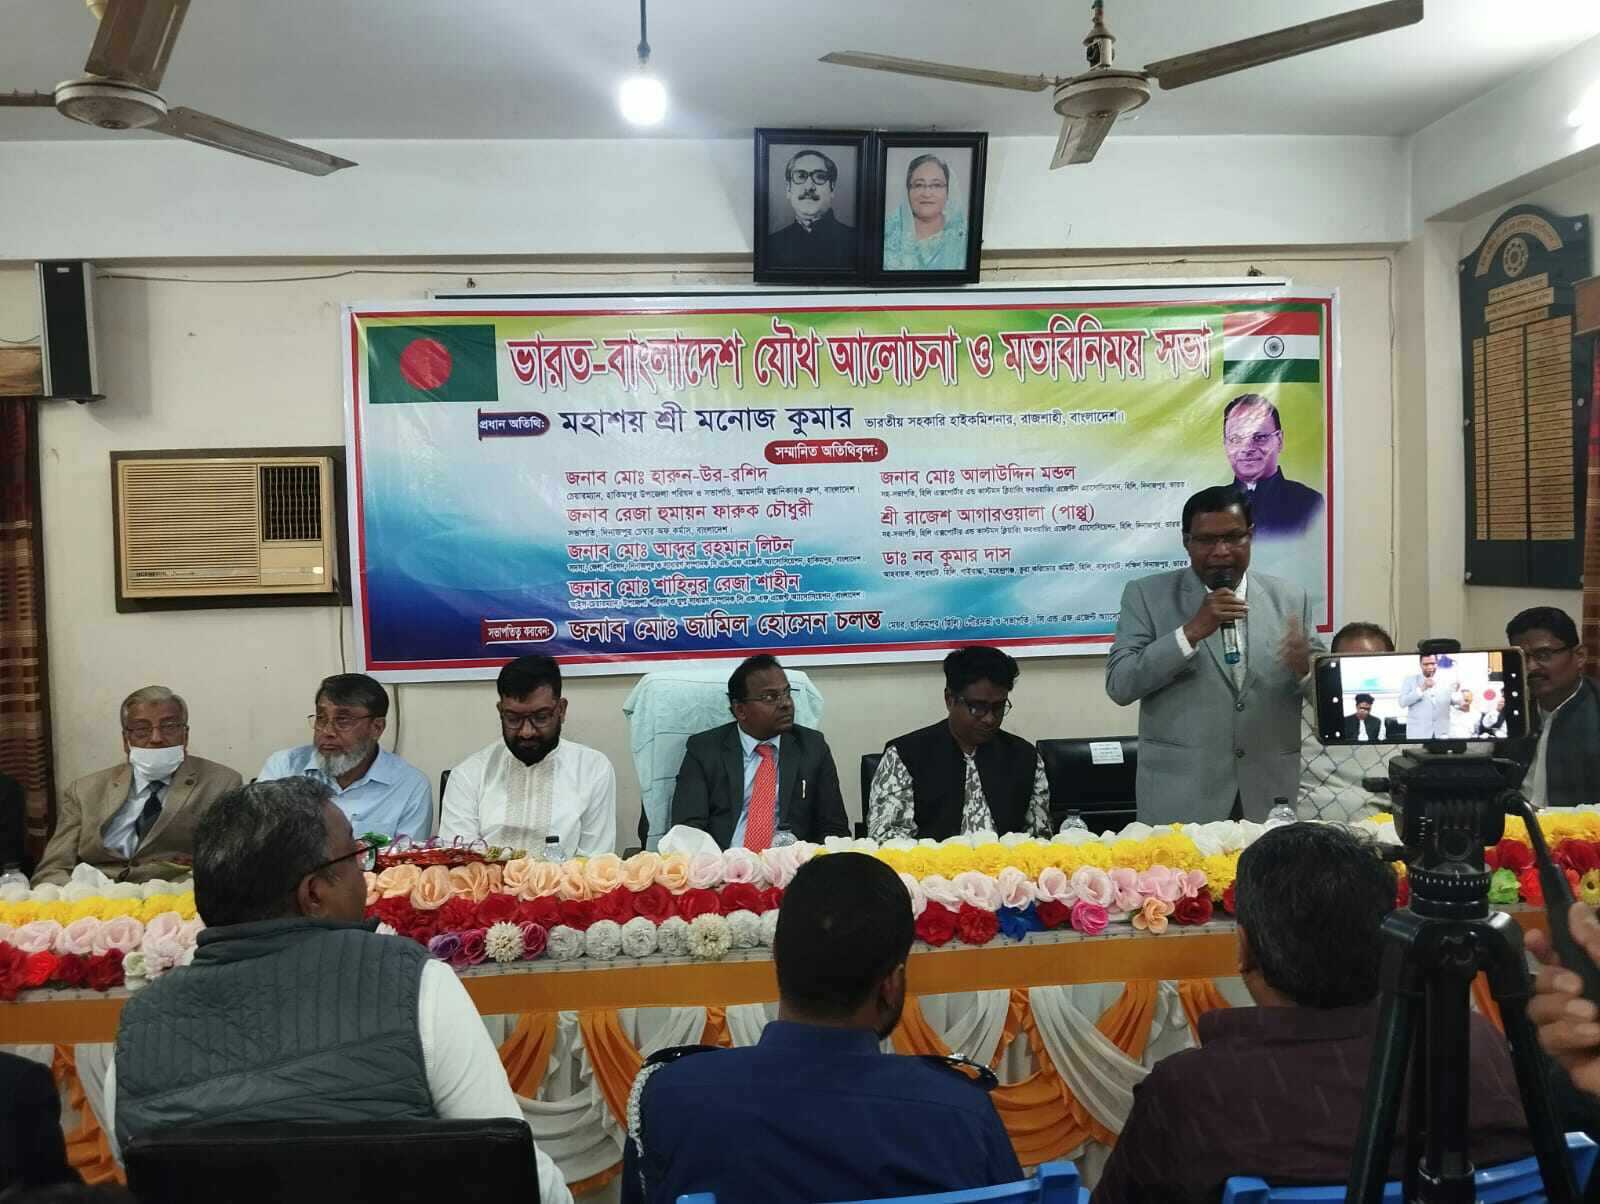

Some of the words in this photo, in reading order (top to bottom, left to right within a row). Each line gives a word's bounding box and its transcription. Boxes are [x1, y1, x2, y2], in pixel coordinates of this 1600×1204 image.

[506, 329, 746, 393] ভারত-বাংলাদেশ
[754, 316, 822, 390] যৌথ
[826, 326, 960, 387] আলোচনা
[967, 333, 994, 378] ও
[1000, 313, 1149, 383] মতবিনিময়
[1151, 320, 1213, 380] সভা
[480, 419, 507, 430] প্রধান
[559, 408, 648, 434] মহাশয়
[655, 401, 687, 433] শ্রী
[695, 408, 777, 432] মনোজ
[785, 404, 853, 437] কুমার
[864, 413, 904, 429] ভারতীয়
[908, 412, 945, 428] সহকারি
[949, 408, 1017, 427] হাইকমিশনার,
[1021, 408, 1066, 427] রাজশাহী,
[775, 442, 818, 459] সম্মানিত
[565, 470, 608, 486] জনাব
[650, 463, 768, 485] হারুন-উর-রশিদ
[880, 469, 920, 485] জনাব
[961, 463, 1035, 484] আলাউদ্দিন
[566, 507, 608, 523] জনাব
[616, 506, 652, 522] রেজা
[712, 503, 759, 520] ফারুক
[766, 497, 813, 520] চৌধুরী
[880, 505, 898, 525] শ্রী
[904, 508, 952, 525] রাজেশ
[957, 505, 1045, 524] আগারওয়ালা
[567, 542, 610, 560] জনাব
[653, 541, 697, 559] আব্দুর
[701, 539, 750, 557] রহমান
[755, 535, 794, 555] লিটন
[912, 550, 934, 564] নব
[939, 548, 980, 568] কুমার
[984, 547, 1011, 562] দাস
[567, 578, 613, 597] জনাব
[654, 572, 709, 596] শাহিনুর
[715, 575, 751, 592] রেজা
[755, 569, 801, 591] শাহীন
[488, 624, 521, 640] সভাপতিত্ব
[568, 618, 627, 643] জনাব
[684, 610, 749, 641] জামিল
[757, 611, 828, 638] হোসেন
[835, 610, 883, 632] চলন্ত
